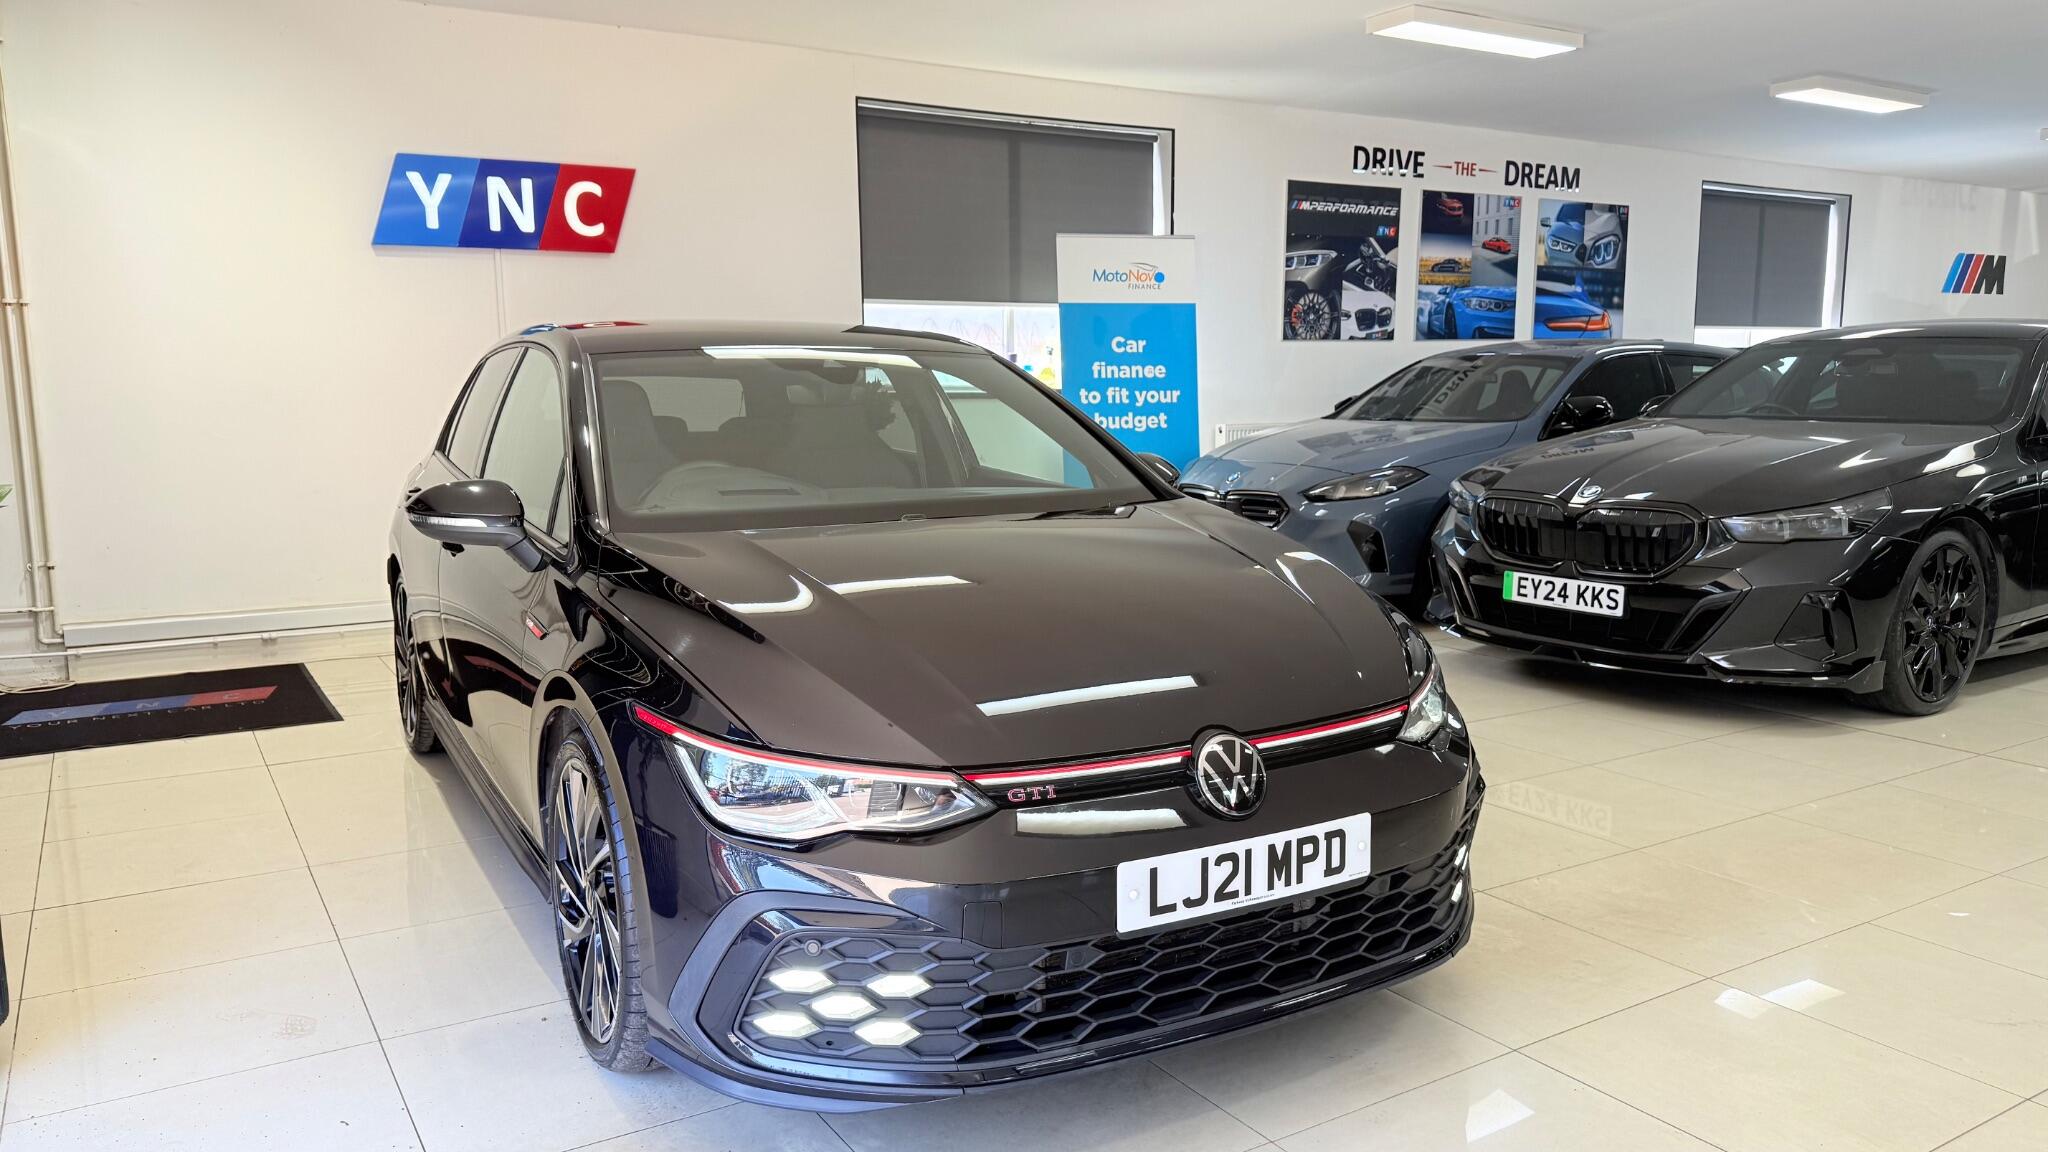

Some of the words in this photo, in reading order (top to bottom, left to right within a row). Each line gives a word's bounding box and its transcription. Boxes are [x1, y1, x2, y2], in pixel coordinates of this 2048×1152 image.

[1353, 145, 1426, 178] DRIVE
[1453, 160, 1477, 177] THE
[1504, 159, 1581, 192] DREAM
[405, 170, 605, 238] YNC
[1111, 335, 1147, 353] Car
[1092, 360, 1167, 379] finance
[1079, 388, 1101, 404] to
[1106, 386, 1130, 404] fit
[1134, 389, 1181, 407] your
[1093, 412, 1168, 432] budget
[1516, 576, 1569, 604] EY24
[1575, 584, 1620, 611] KKS
[1007, 784, 1057, 802] GTI
[1149, 847, 1253, 917] LJ21
[1267, 828, 1347, 892] MPD
